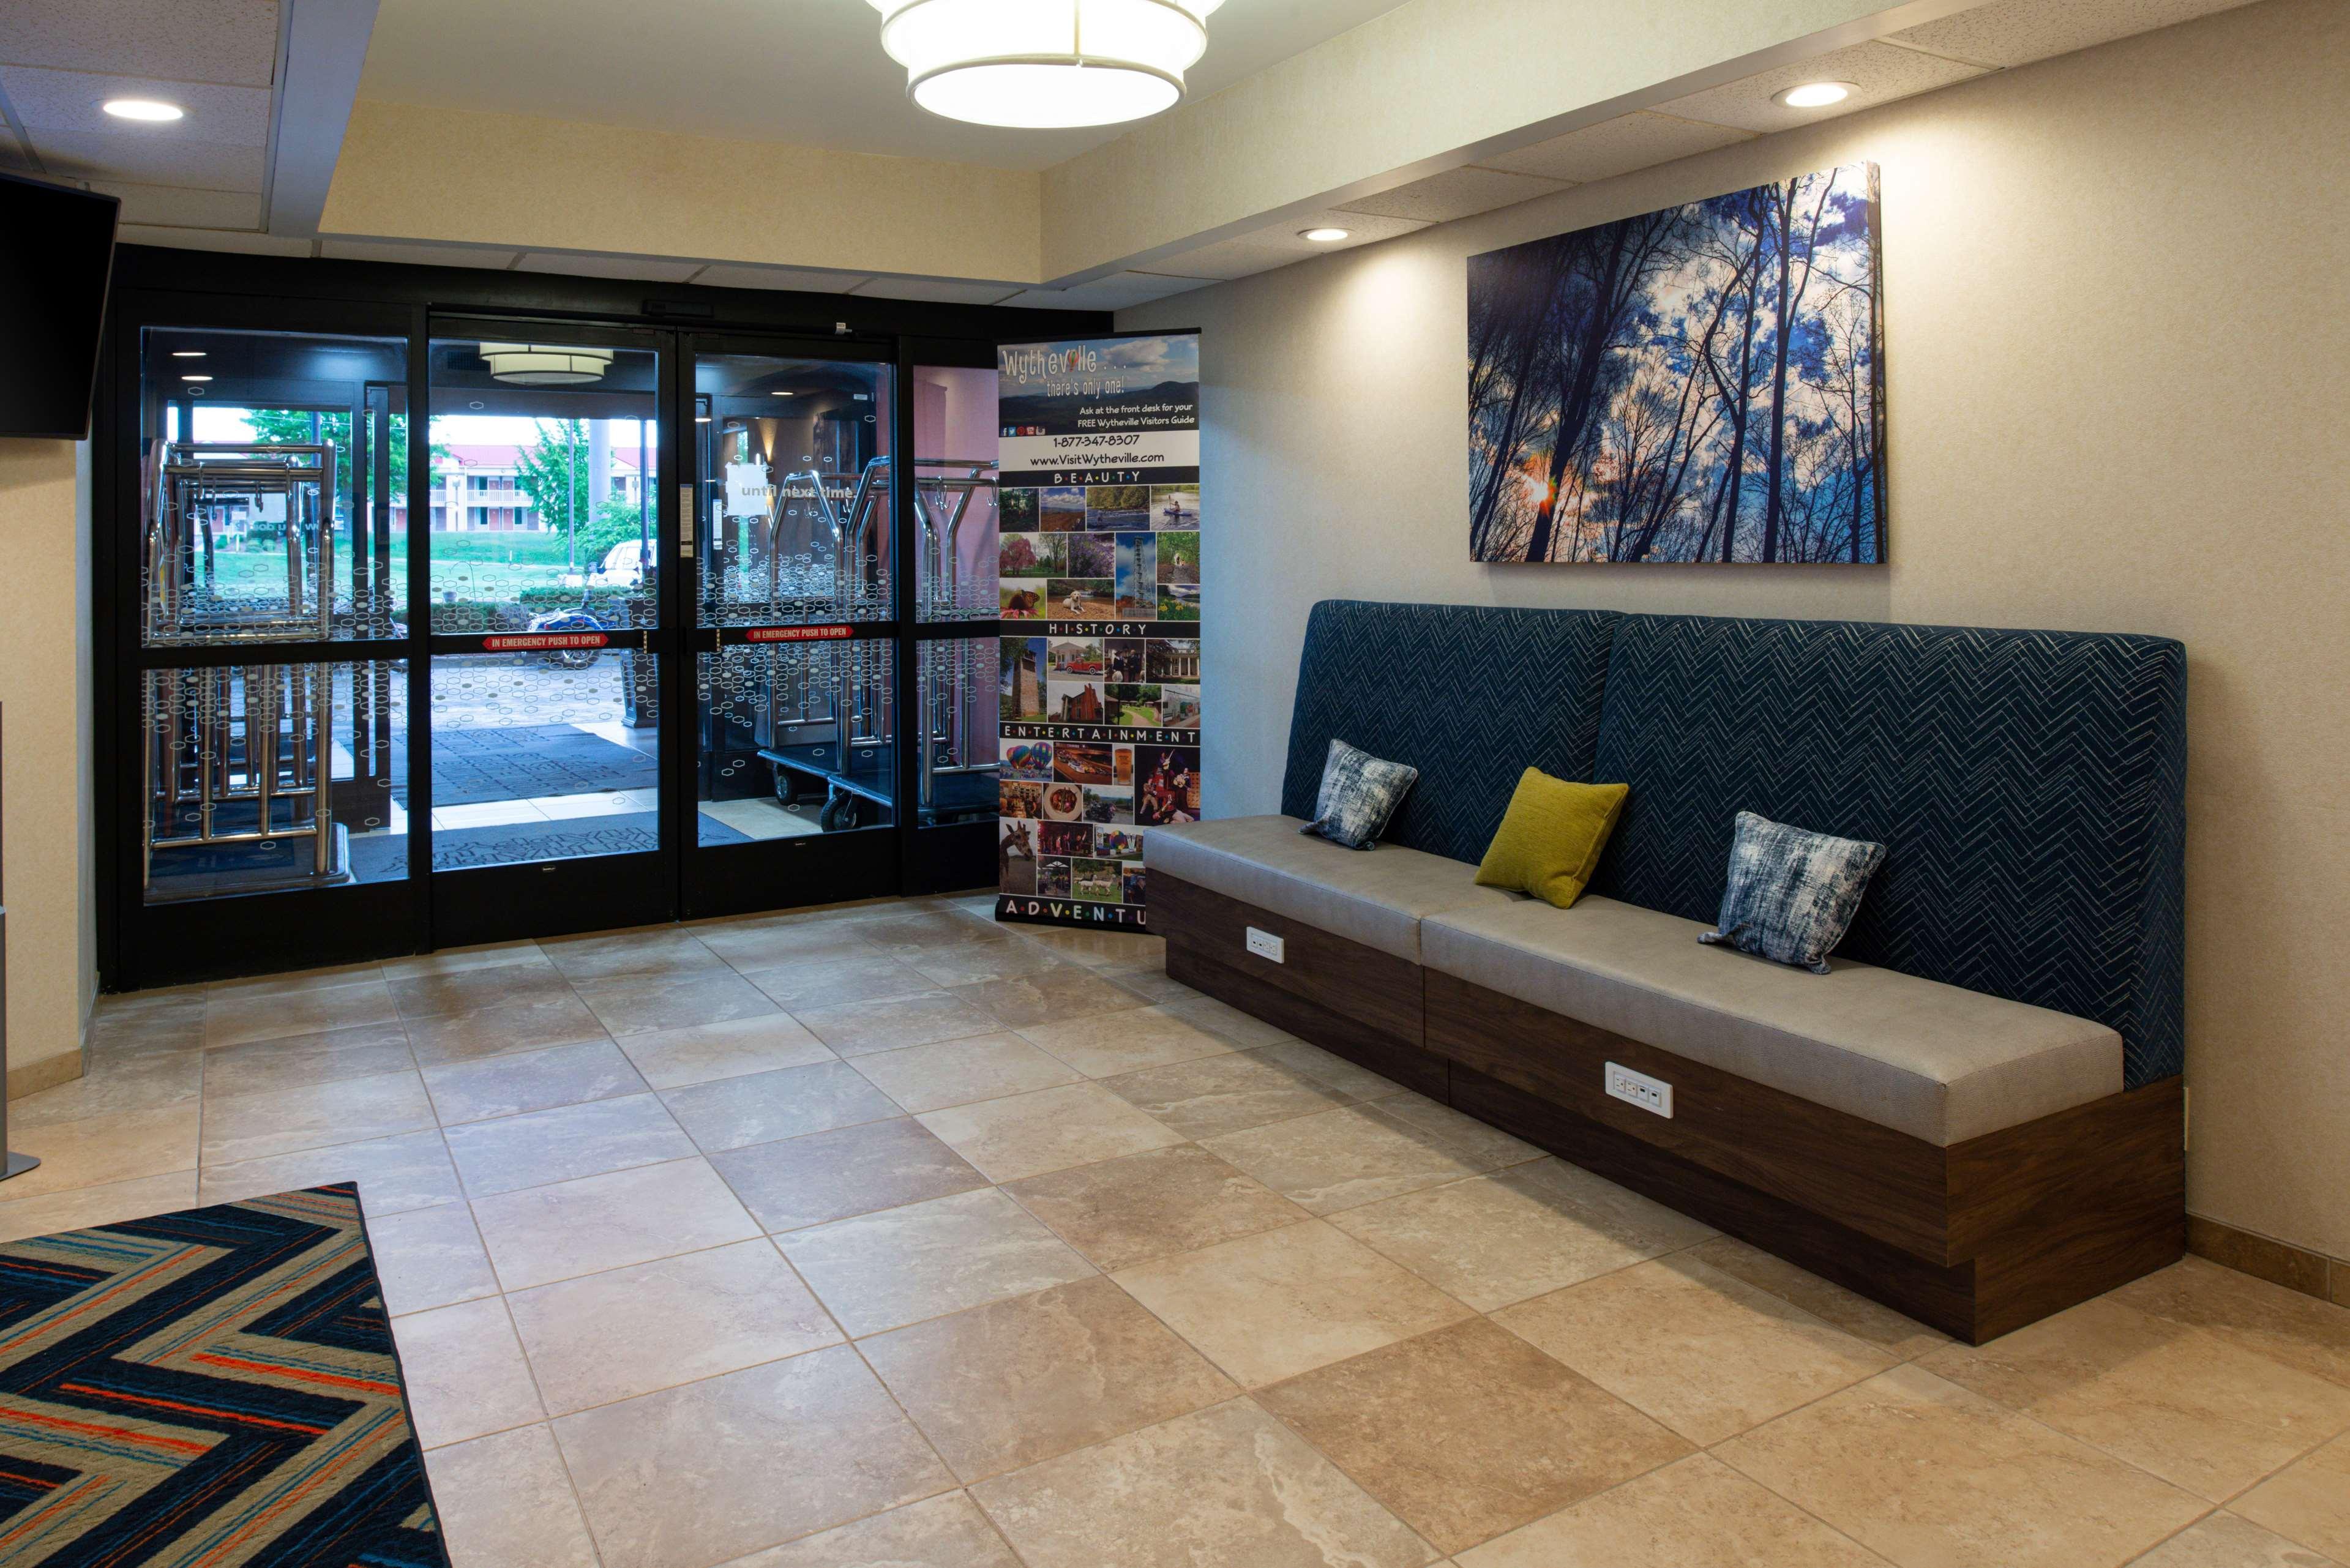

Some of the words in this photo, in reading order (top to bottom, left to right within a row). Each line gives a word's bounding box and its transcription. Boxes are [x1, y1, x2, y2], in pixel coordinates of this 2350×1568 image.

[1047, 376, 1079, 397] there's
[1083, 376, 1101, 399] only
[1104, 375, 1124, 394] one!
[1121, 404, 1140, 413] front
[1142, 404, 1161, 413] desk
[1162, 403, 1173, 412] for
[1174, 403, 1193, 414] your
[1097, 417, 1139, 428] Wytheville
[1140, 417, 1170, 425] Visitors
[1170, 416, 1195, 424] Guide
[1053, 435, 1140, 447] 1-877-347-8307
[1030, 452, 1164, 466] www.VisitWytheville.com
[741, 484, 777, 497] until
[782, 487, 815, 498] next
[754, 630, 761, 639] IN
[762, 629, 800, 638] EMERGENCY
[801, 629, 818, 637] PUSH
[820, 628, 828, 637] TO
[829, 627, 847, 636] OPEN
[492, 638, 500, 648] IN
[502, 637, 546, 647] EMERGENCY
[548, 636, 568, 646] PUSH
[569, 636, 579, 644] TO
[581, 635, 601, 644] OPEN
[1006, 899, 1146, 925] ADVENTU
